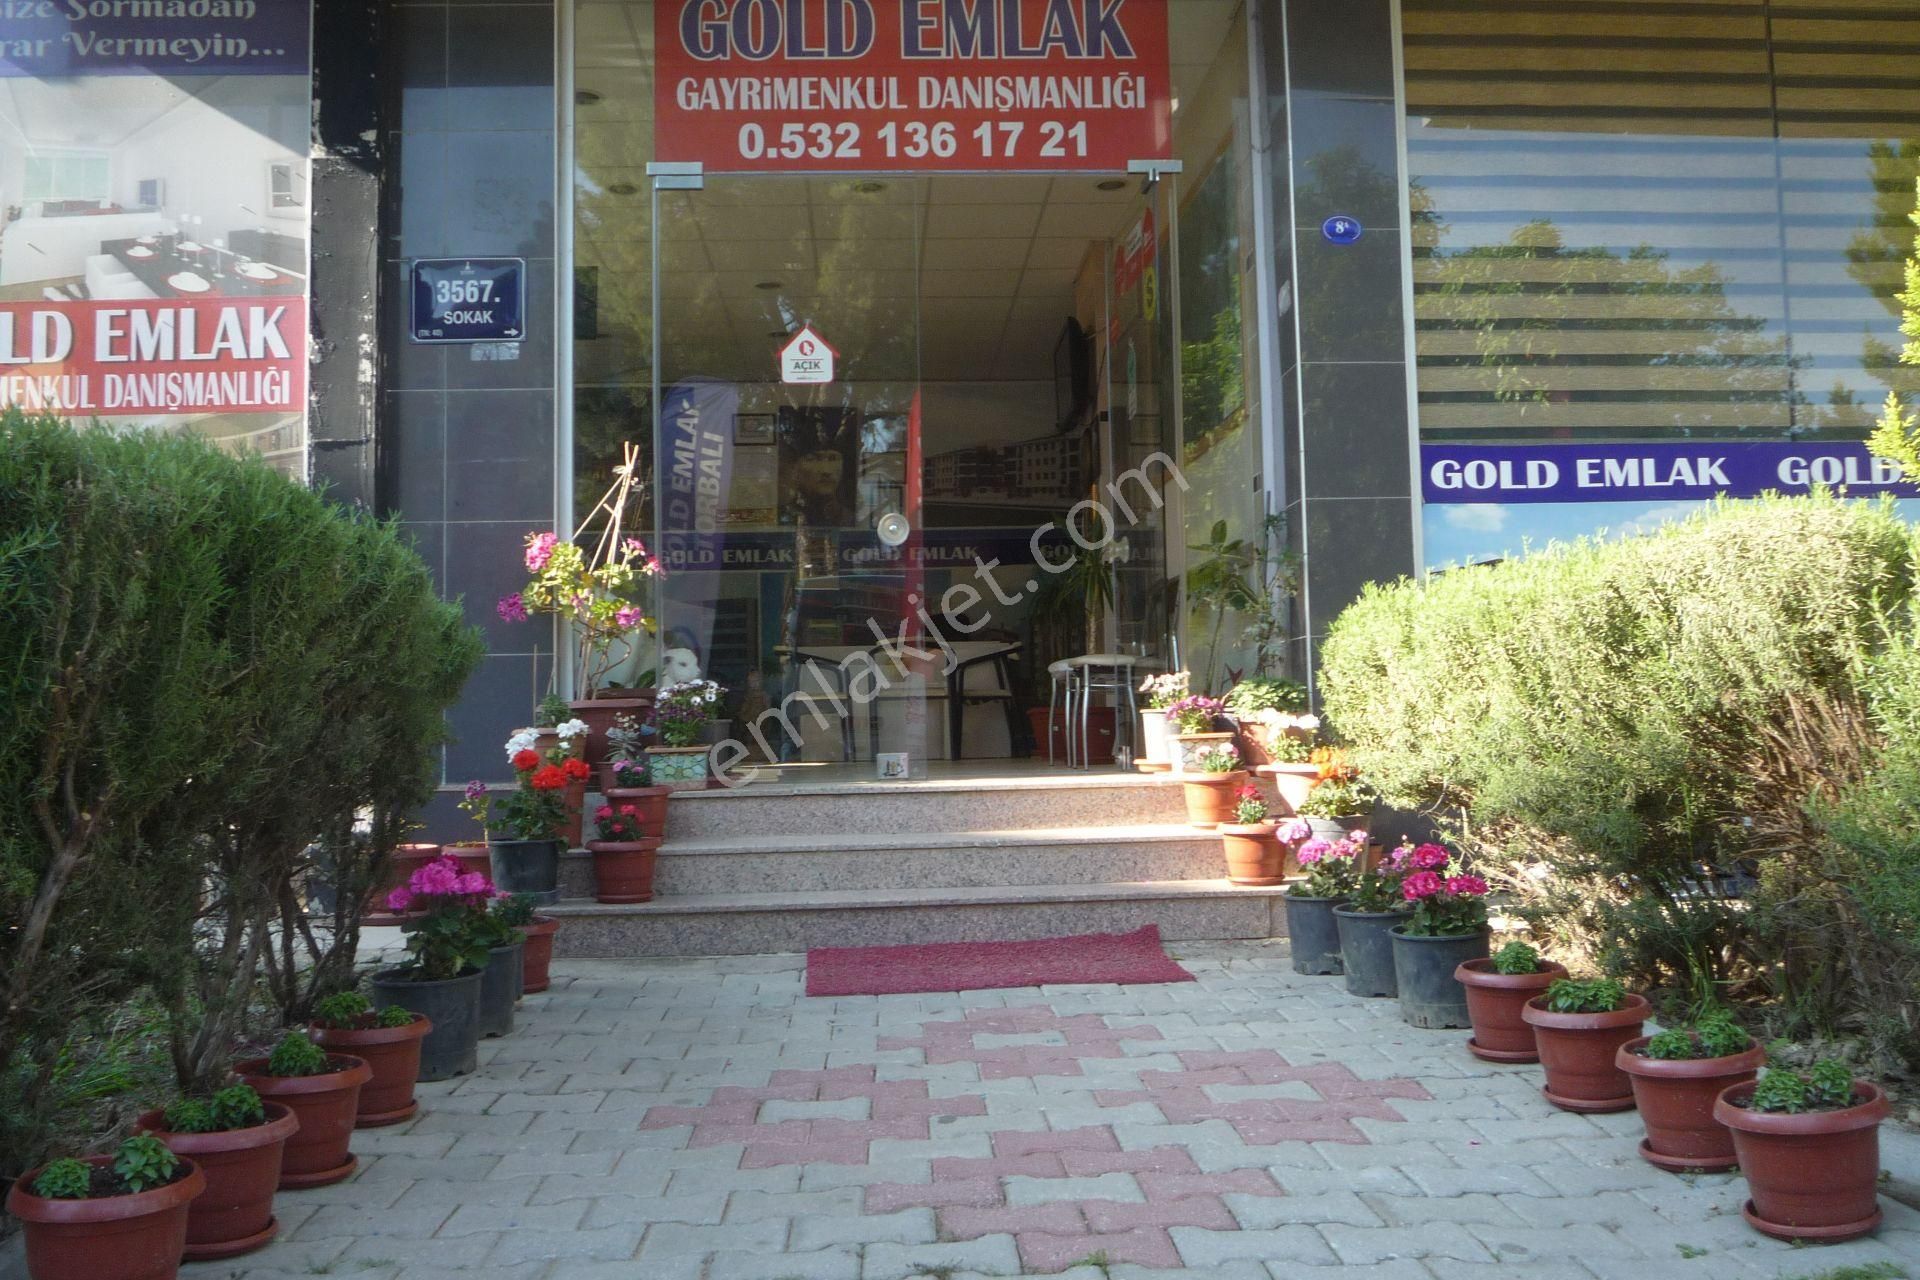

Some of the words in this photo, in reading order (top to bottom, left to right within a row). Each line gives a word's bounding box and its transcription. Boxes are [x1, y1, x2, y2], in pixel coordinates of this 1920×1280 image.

[0, 0, 54, 19] ize
[61, 30, 286, 62] Vermeyin...
[679, 0, 875, 60] GOLD
[900, 0, 1136, 60] EMLAK
[919, 73, 1146, 112] DANIŞMANLIĞI
[737, 121, 861, 158] 0.532
[877, 121, 956, 158] 136
[974, 121, 1024, 157] 17
[1040, 121, 1087, 157] 21
[436, 279, 501, 303] 3567.
[443, 310, 494, 324] SOKAK
[95, 306, 291, 362] EMLAK
[793, 361, 821, 373] AÇIK
[103, 366, 291, 411] DANIŞMANLIĞI
[1430, 459, 1560, 490] GOLD
[1576, 457, 1732, 488] EMLAK
[1777, 456, 1903, 485] GOLD
[723, 548, 794, 564] EMLAK
